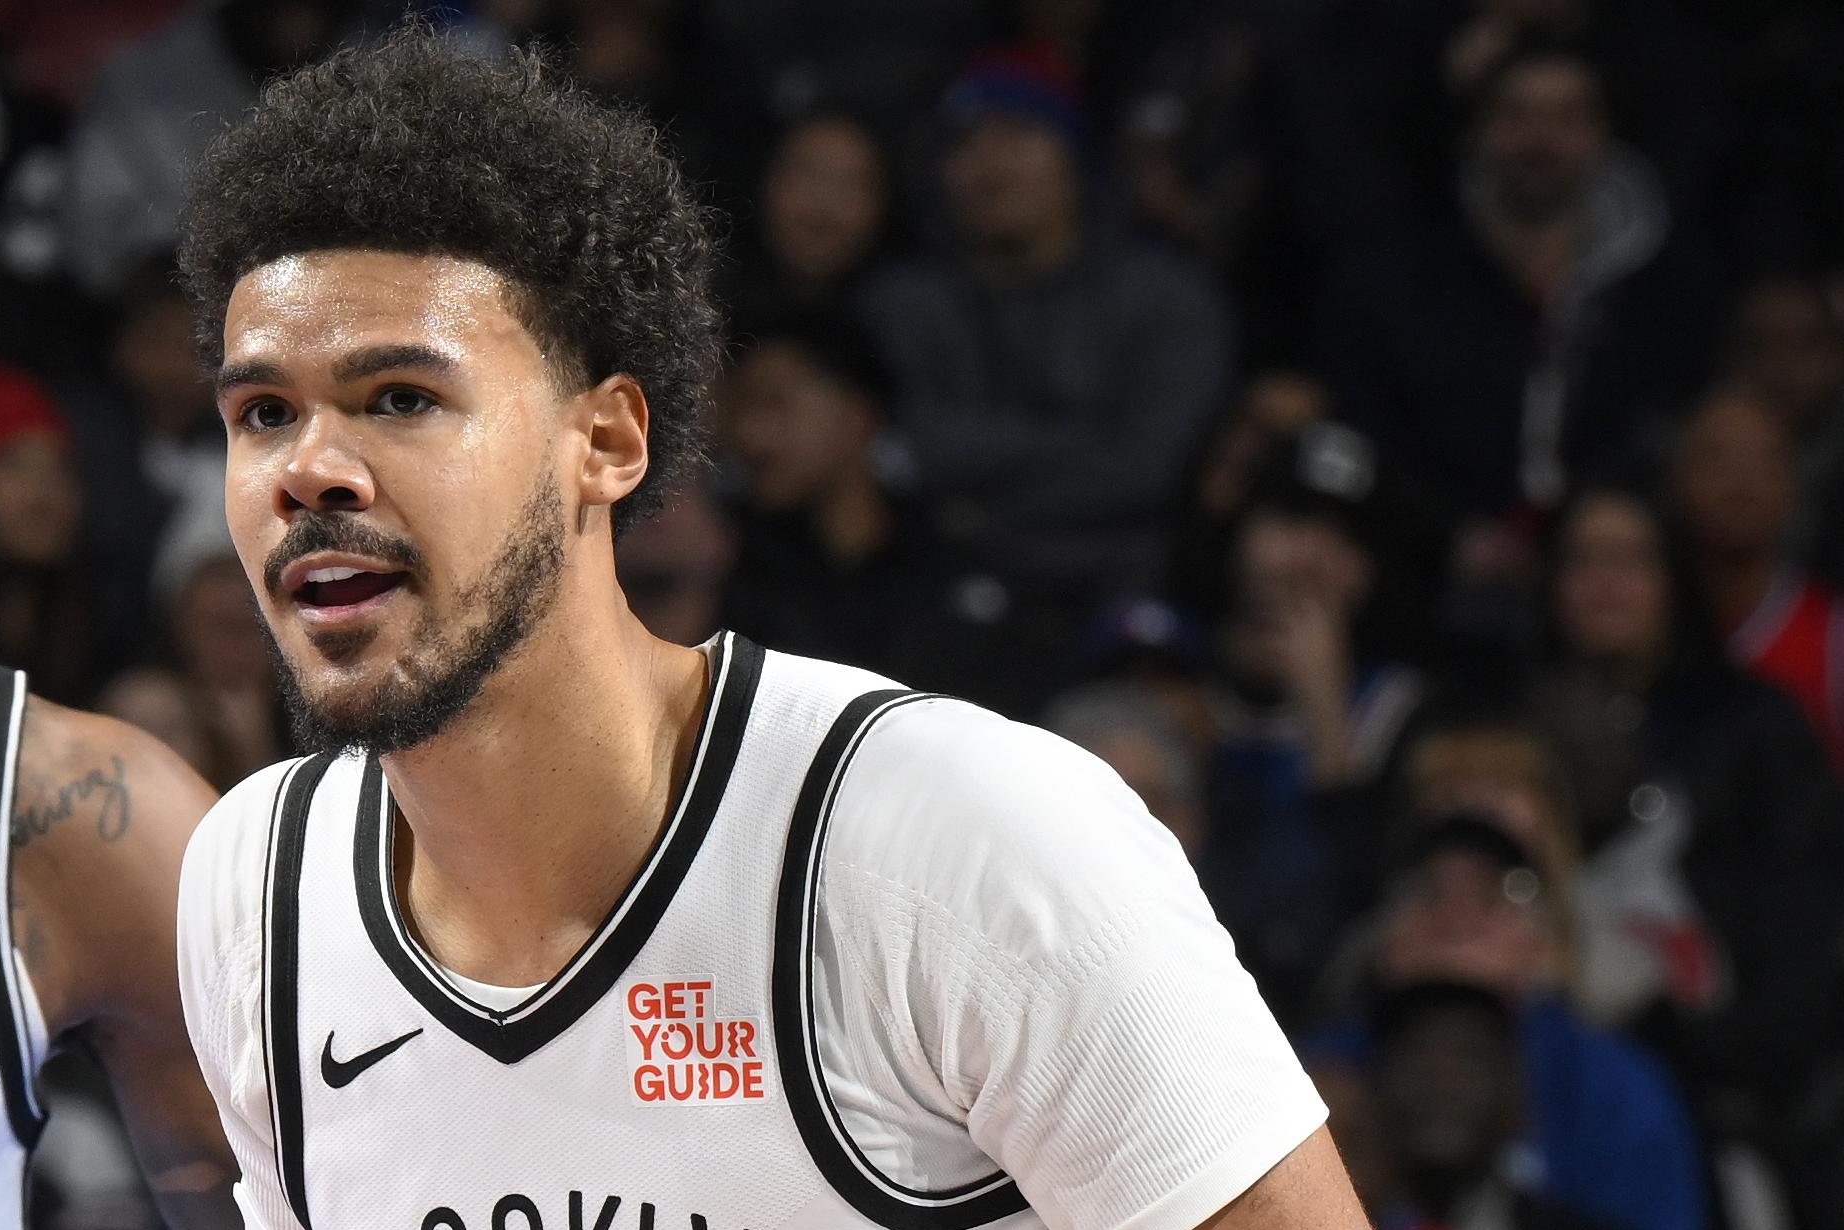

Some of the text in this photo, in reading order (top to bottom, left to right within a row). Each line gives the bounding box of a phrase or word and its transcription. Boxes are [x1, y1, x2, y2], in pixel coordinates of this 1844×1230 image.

[627, 981, 712, 1021] GET
[629, 1020, 757, 1061] YOUR
[633, 1061, 765, 1102] GUIDE
